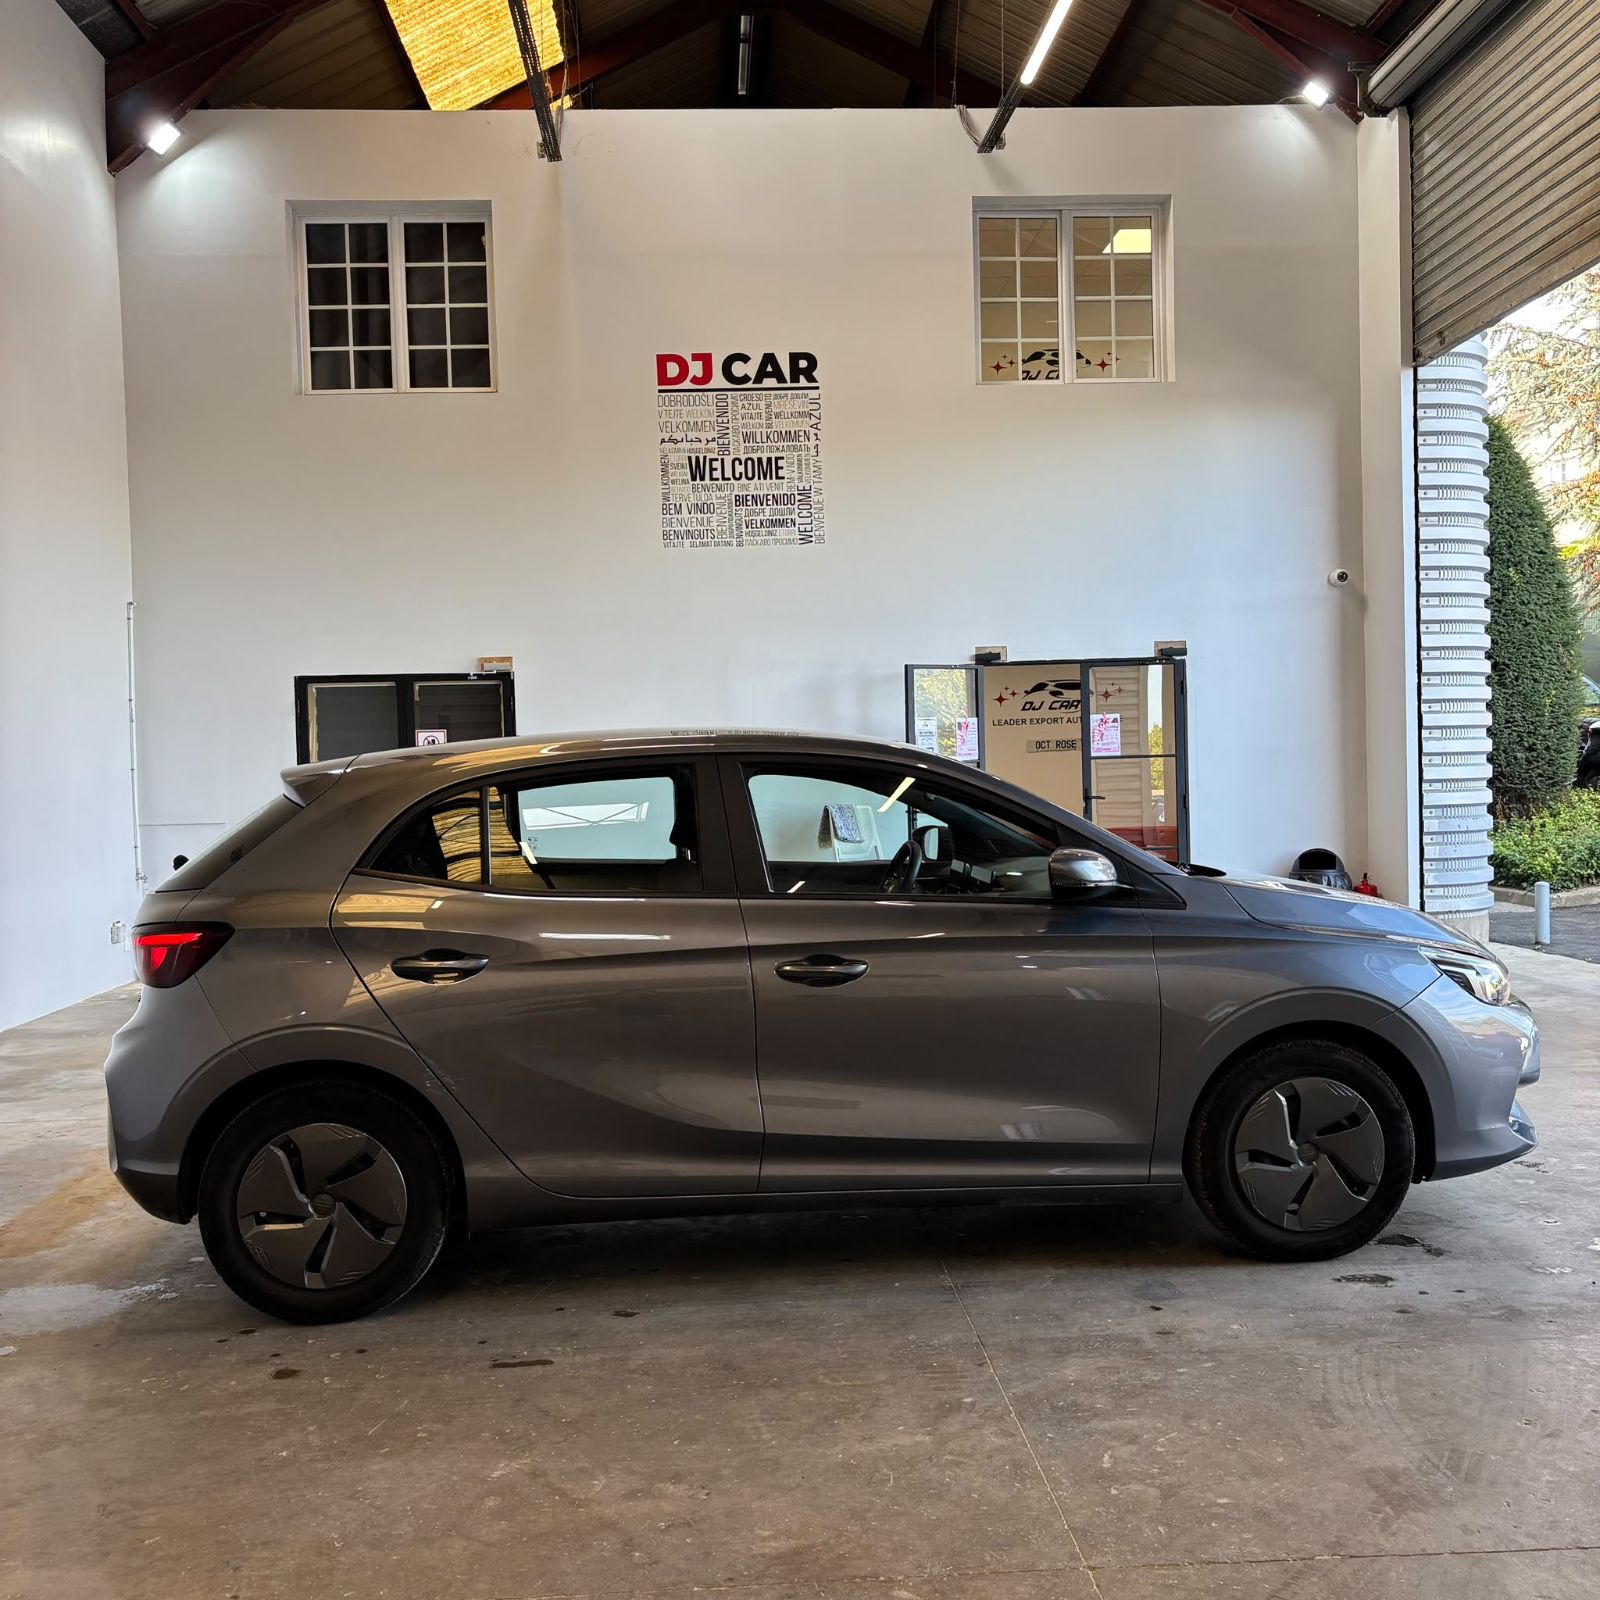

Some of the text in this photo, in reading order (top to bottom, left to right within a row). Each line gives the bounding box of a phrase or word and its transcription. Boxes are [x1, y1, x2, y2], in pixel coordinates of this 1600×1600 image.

[656, 352, 819, 386] DJ CAR
[740, 402, 764, 411] AZUL
[809, 393, 822, 431] AZUL
[741, 412, 764, 421] VITAJTE
[658, 420, 716, 433] VELKOMMEN
[715, 393, 730, 456] BIENVENIDO
[741, 430, 811, 444] WILLKOMMEN
[687, 455, 785, 482] WELCOME
[691, 483, 735, 493] BENVENUTO
[734, 493, 796, 507] BIENVENIDO
[661, 502, 716, 516] BEM VINDO
[797, 485, 814, 545] WELCOME
[662, 516, 714, 528] BIENVENUE
[716, 493, 728, 540] BIENVENUE
[813, 498, 826, 544] BIENVENUE
[744, 518, 796, 529] VELKOMMEN
[662, 528, 716, 541] BENVINGUTS
[1021, 700, 1045, 711] DJ
[992, 718, 1027, 727] LEADER
[1029, 716, 1064, 725] EXPORT
[1035, 740, 1077, 750] OCT ROSE
